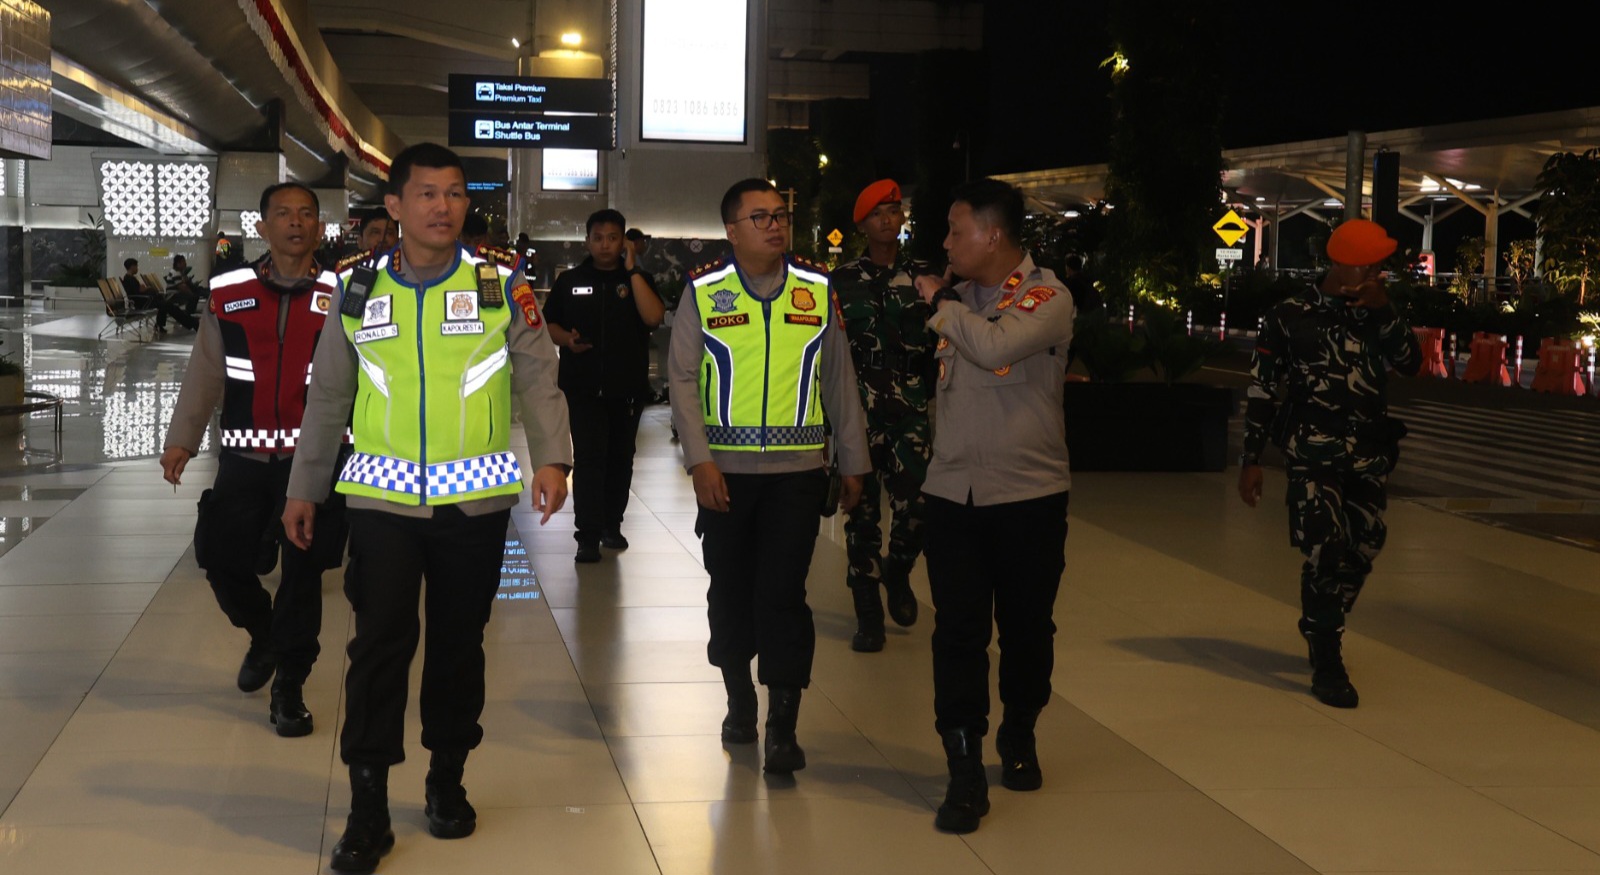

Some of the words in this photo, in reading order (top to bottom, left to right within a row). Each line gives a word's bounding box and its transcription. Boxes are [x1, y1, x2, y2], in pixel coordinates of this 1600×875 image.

[495, 83, 513, 91] Taksi
[514, 84, 546, 93] Premium
[495, 94, 526, 103] Premium
[527, 95, 542, 103] Taxi
[653, 99, 678, 114] 0823
[495, 120, 511, 129] Bus
[512, 121, 534, 130] Antar
[535, 122, 570, 131] Terminal
[495, 131, 523, 140] Shuttle
[524, 131, 541, 141] Bus
[711, 315, 744, 327] JOKO
[391, 326, 397, 336] S
[442, 325, 483, 334] KAPOLRESTA
